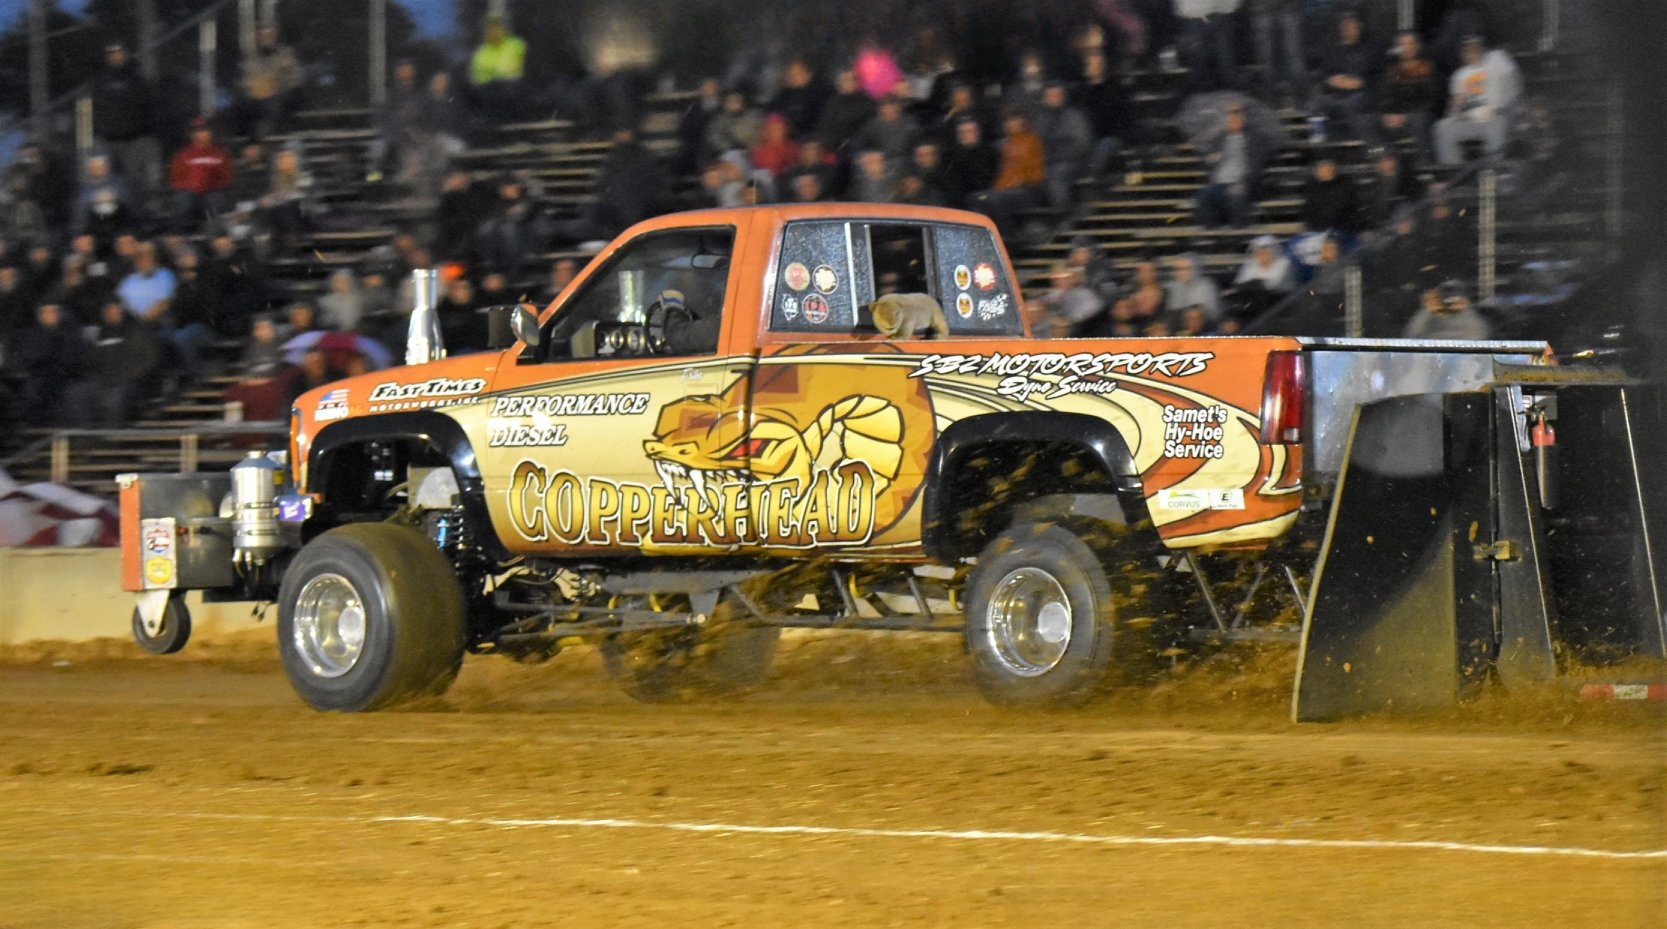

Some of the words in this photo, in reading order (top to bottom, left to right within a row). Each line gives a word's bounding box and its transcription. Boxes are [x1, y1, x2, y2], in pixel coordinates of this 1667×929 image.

[975, 351, 1215, 377] MOTORSPORTS
[996, 375, 1052, 403] Dyno
[1045, 375, 1118, 400] Service
[490, 393, 650, 417] PERFORMANCE
[1162, 404, 1228, 423] Samet's
[489, 424, 568, 448] DIESEL
[1164, 422, 1224, 443] Hy-Hoe
[1164, 440, 1224, 459] Service
[507, 458, 876, 549] COPPERHEAD
[1167, 500, 1201, 509] CORVUS
